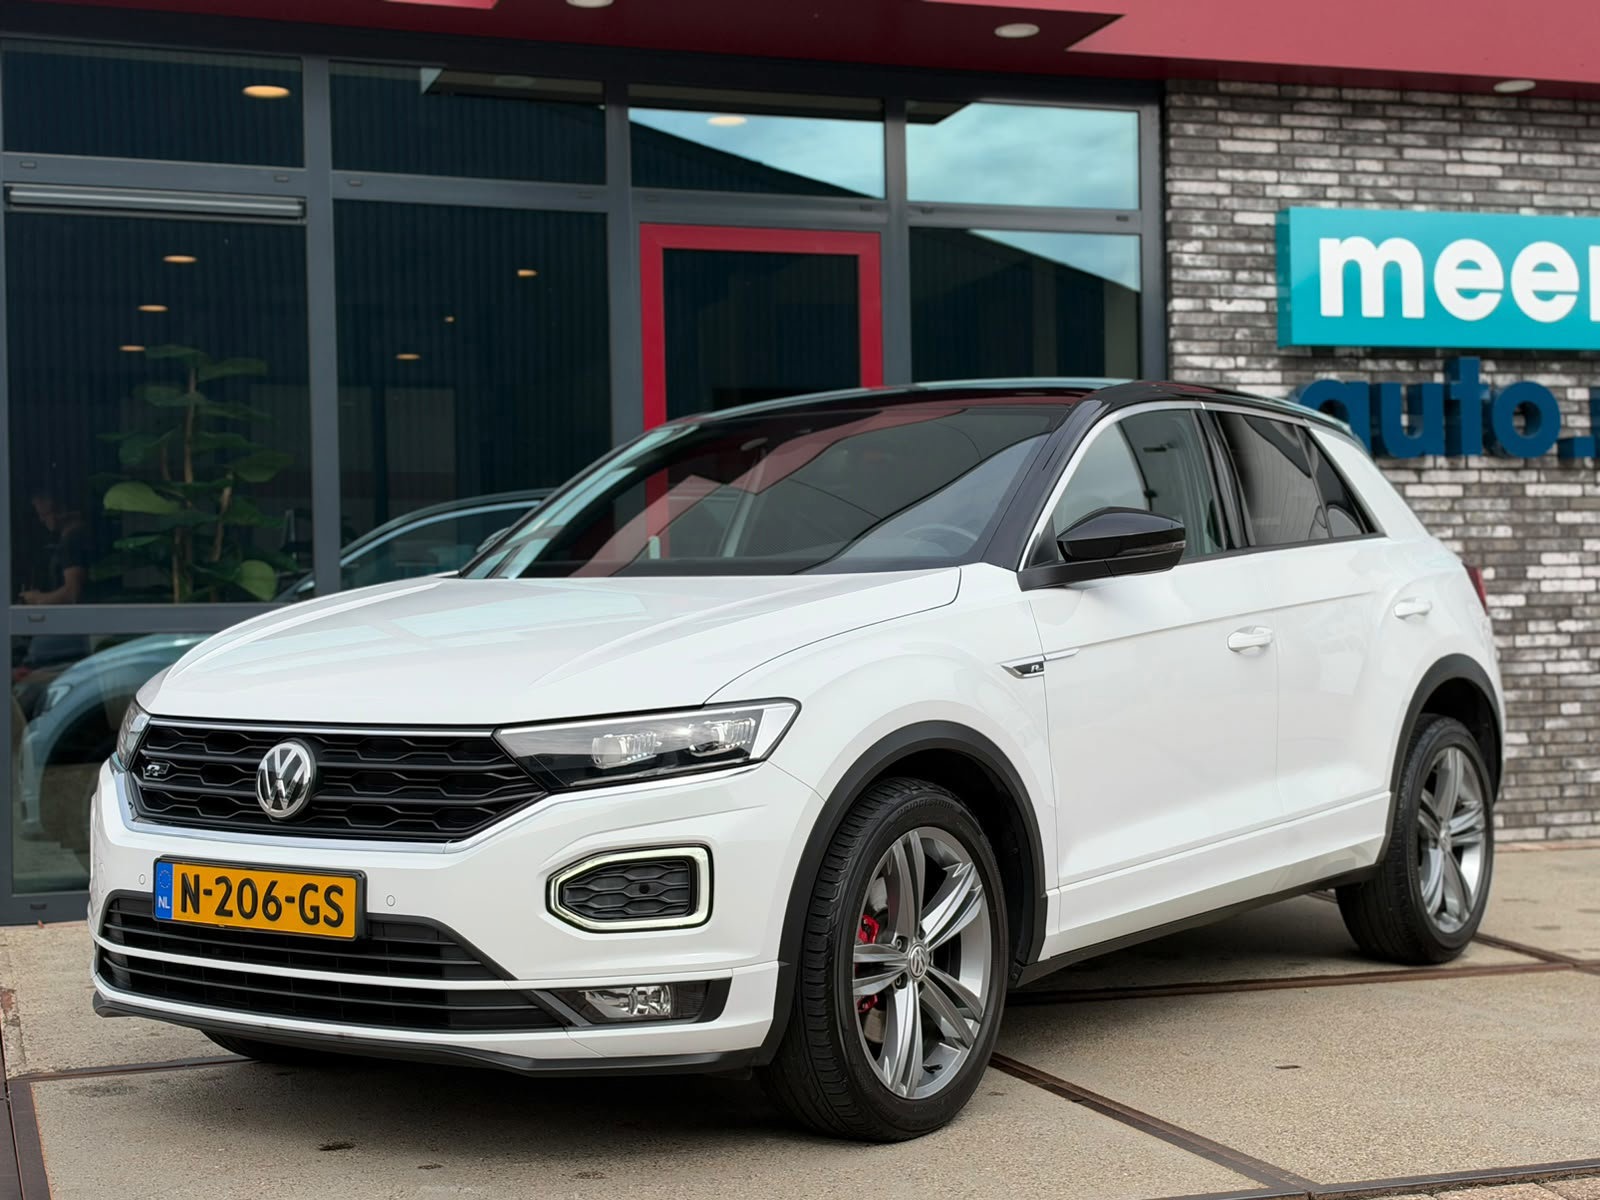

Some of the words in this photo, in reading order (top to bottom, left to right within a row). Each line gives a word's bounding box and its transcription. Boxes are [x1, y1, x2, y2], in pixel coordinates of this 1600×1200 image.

[1318, 236, 1600, 323] mee
[158, 895, 171, 910] NL
[180, 872, 345, 928] N-206-GS
